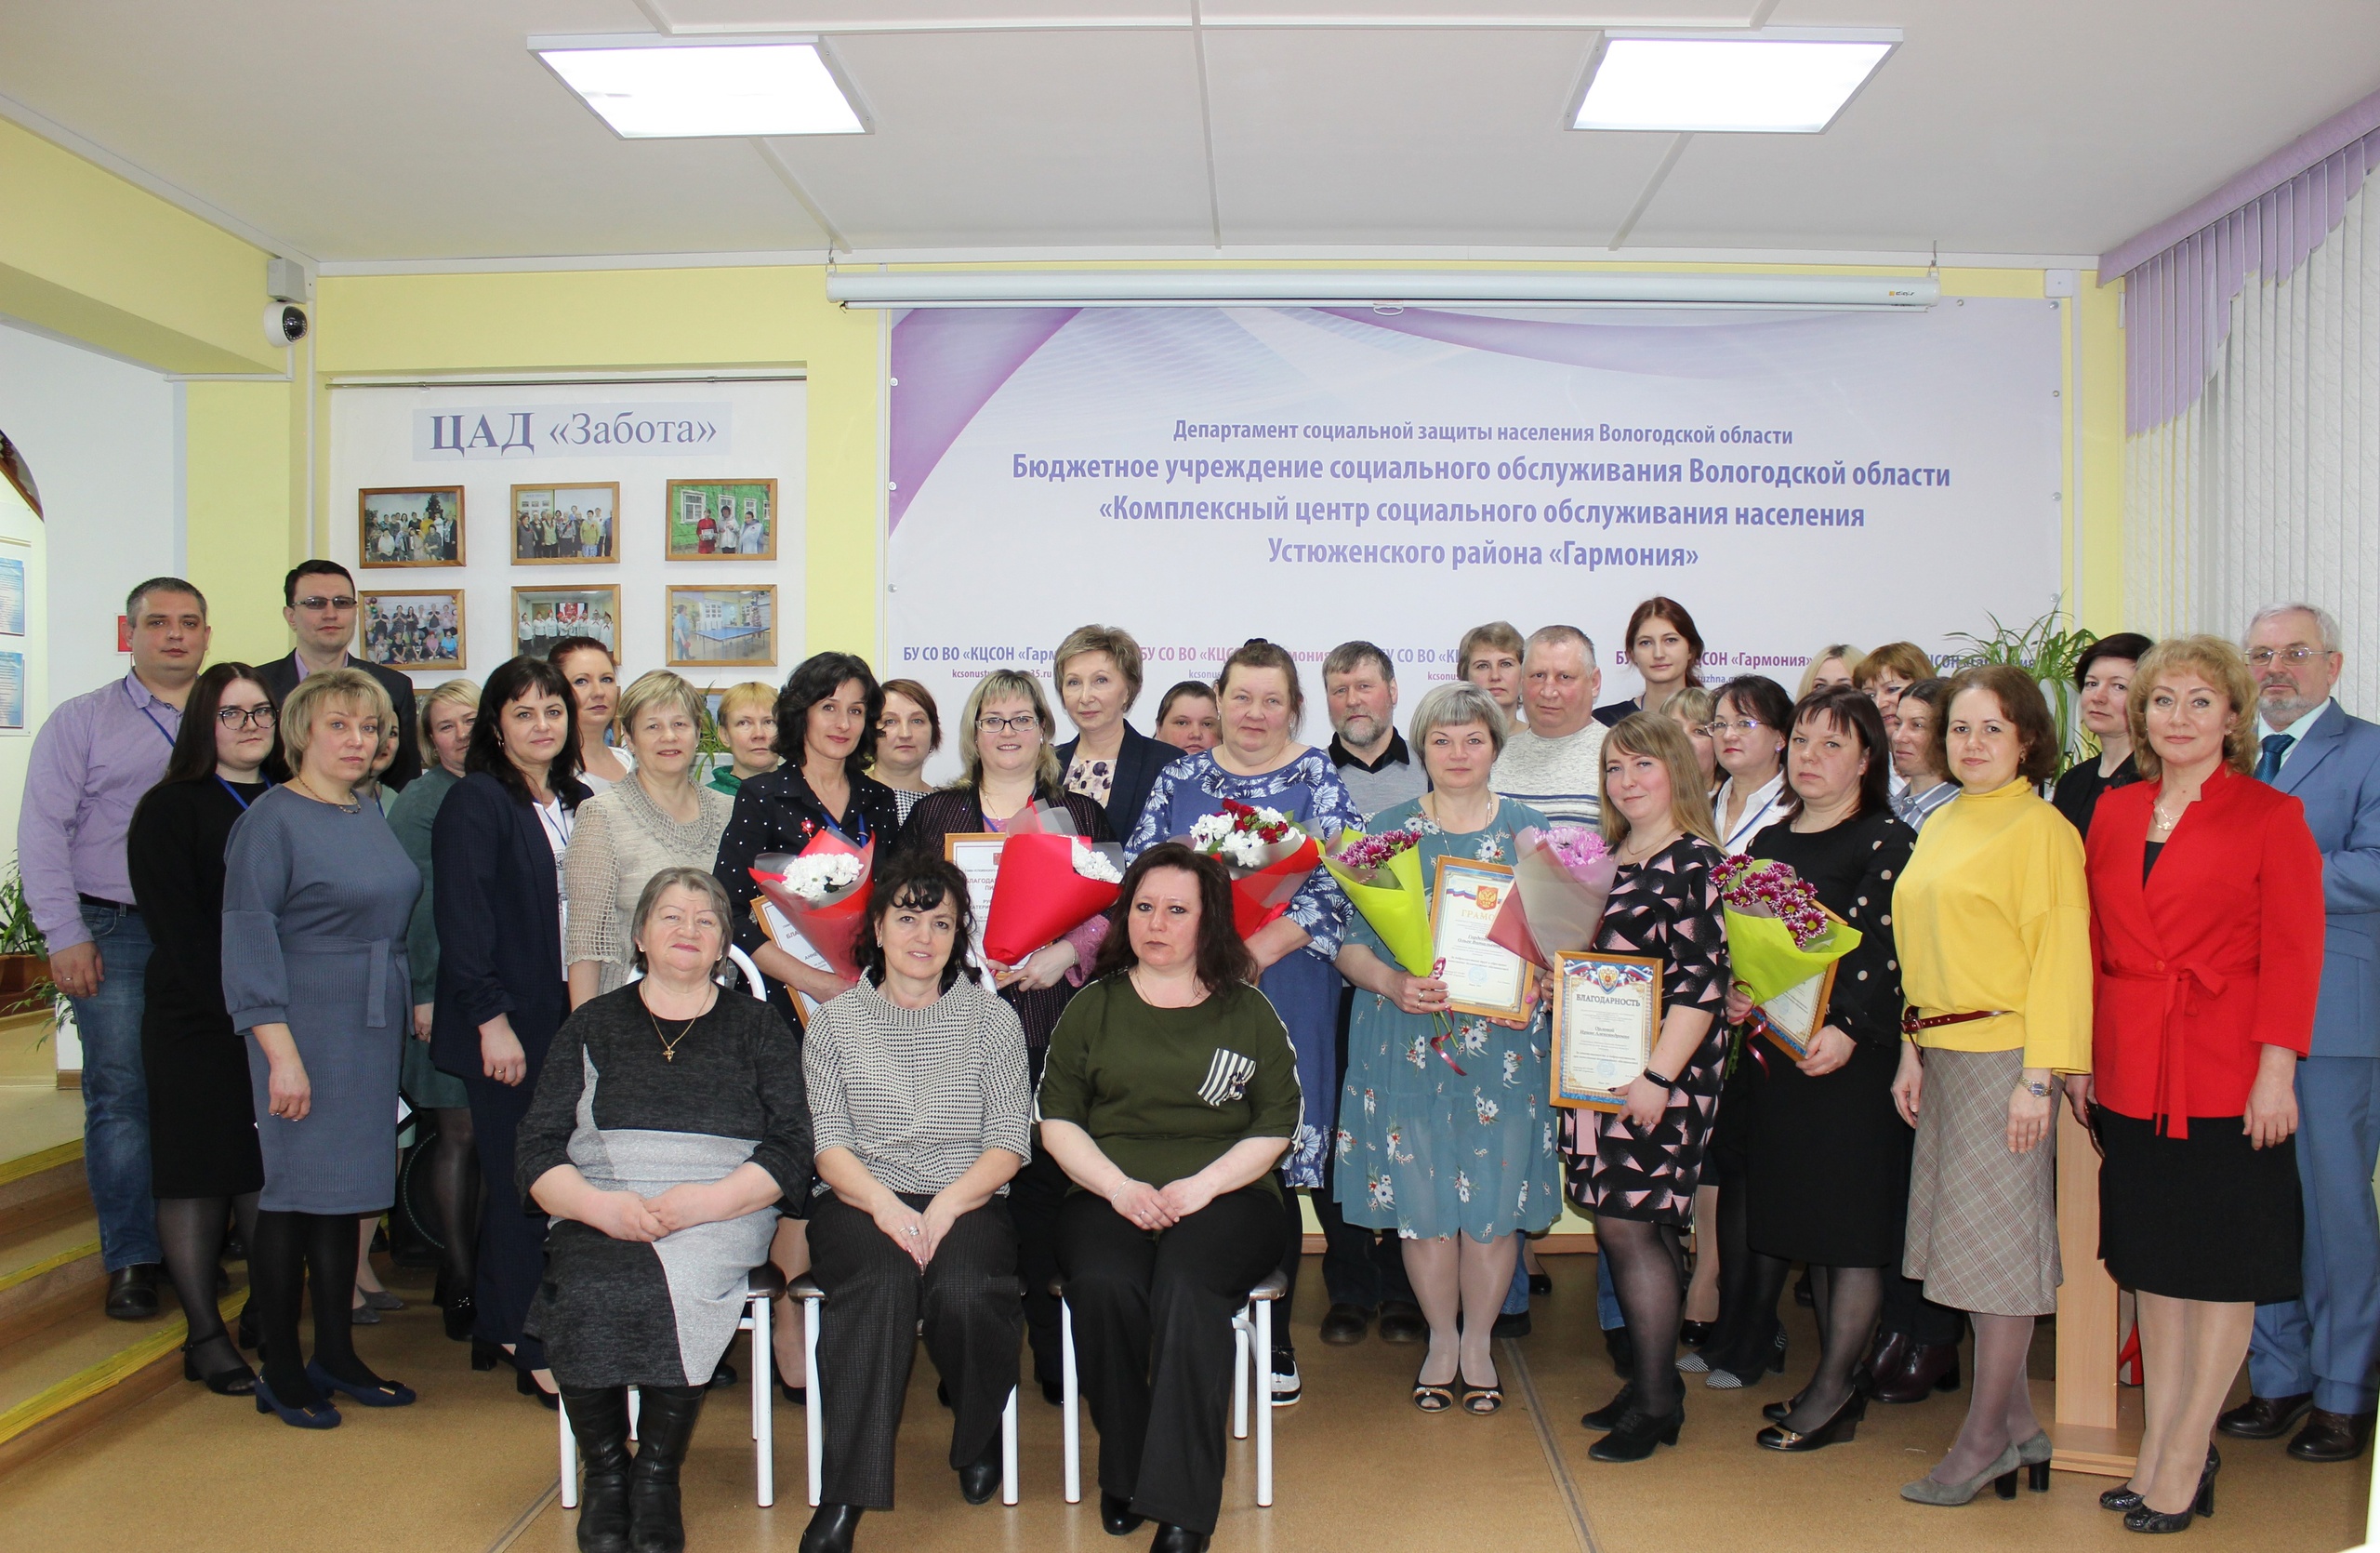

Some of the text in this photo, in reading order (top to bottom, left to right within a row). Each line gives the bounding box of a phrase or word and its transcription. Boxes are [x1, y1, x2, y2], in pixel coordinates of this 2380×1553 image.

[429, 410, 718, 458] ЦАД «Забота»
[1173, 419, 1793, 446] Департамент социальной защиты населения Вологодской области
[1012, 453, 1950, 489] Бюджетное учреждение социального обслуживания Вологодской области
[1099, 495, 1865, 532] «Комплексный центр социального обслуживания населения
[1267, 538, 1699, 572] Устюженского района «Гармония»
[903, 646, 1055, 664] БУ СО ВО «КЦСОН «Гарм
[1158, 646, 1175, 661] СО
[1178, 646, 1197, 661] ВО
[1396, 648, 1414, 662] СО
[1417, 648, 1435, 663] ВО
[1731, 653, 1813, 670] «Гармония»
[1576, 993, 1641, 1007] БЛАГОДАРНОСТЬ
